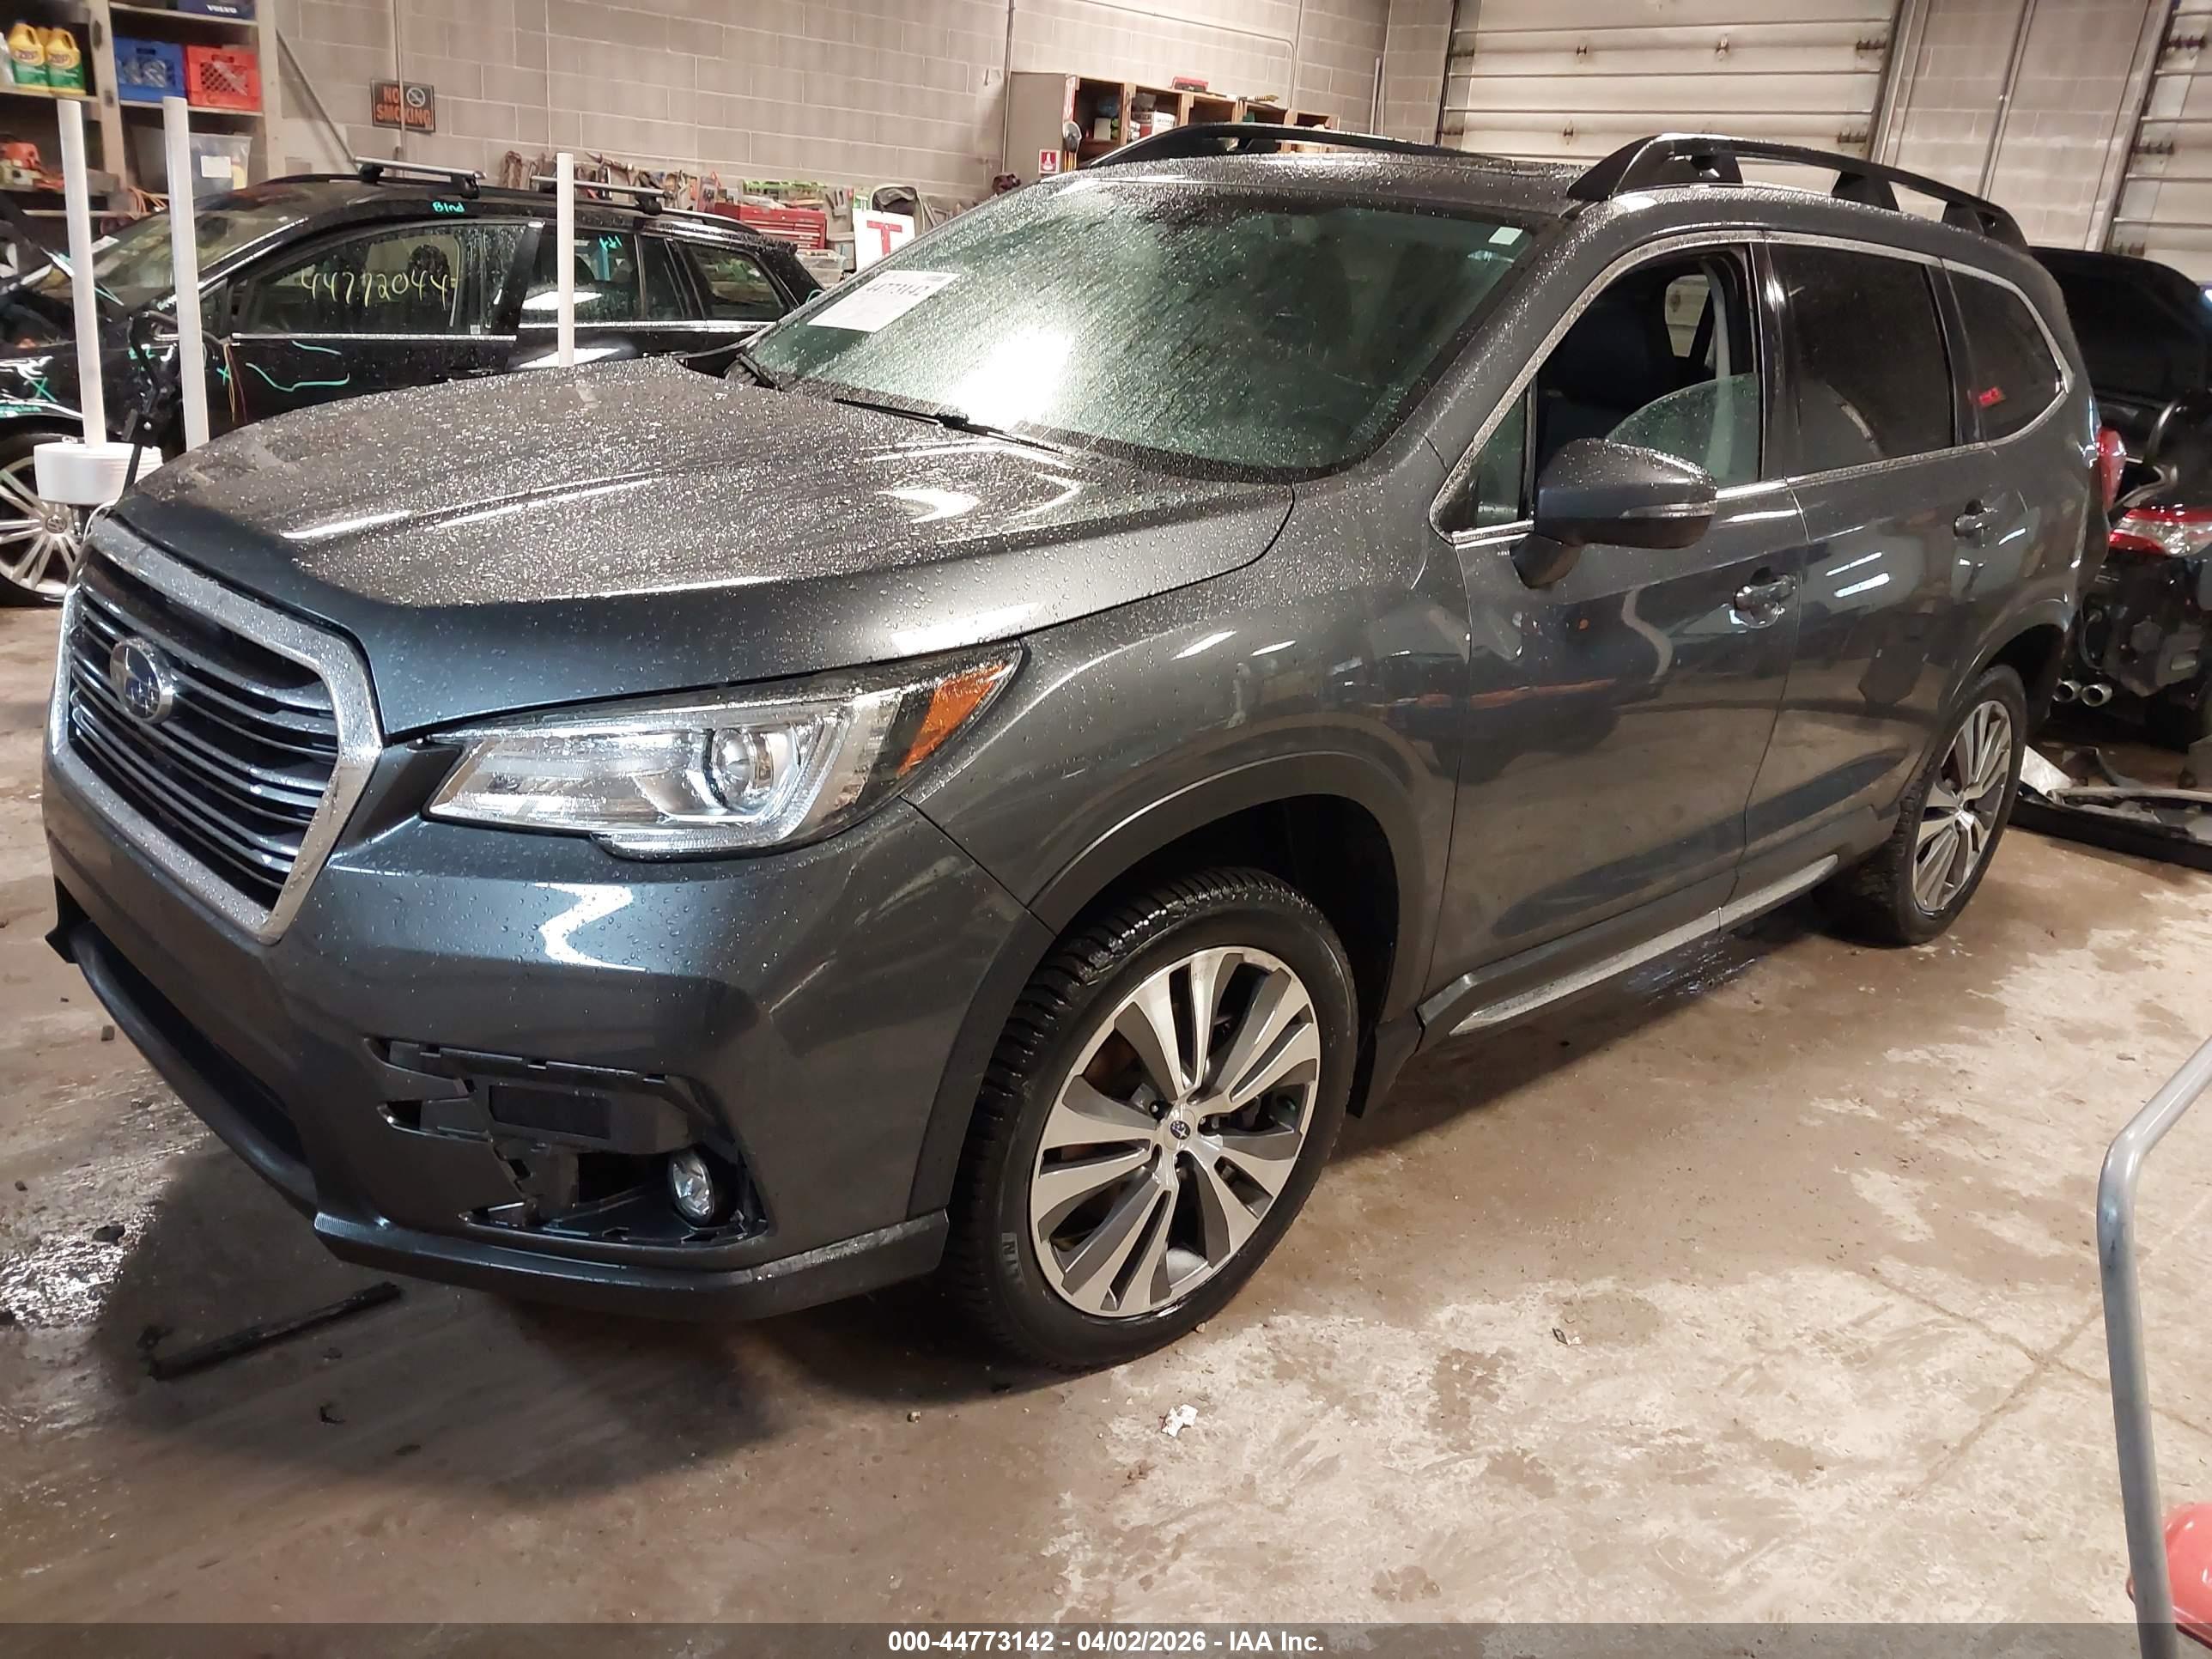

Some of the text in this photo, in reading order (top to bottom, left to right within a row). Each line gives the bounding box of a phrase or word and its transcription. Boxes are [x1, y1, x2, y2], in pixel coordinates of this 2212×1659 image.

[207, 4, 238, 14] VOLVO
[383, 86, 400, 104] NO
[377, 104, 432, 125] SMOKING
[301, 269, 448, 311] 44772044
